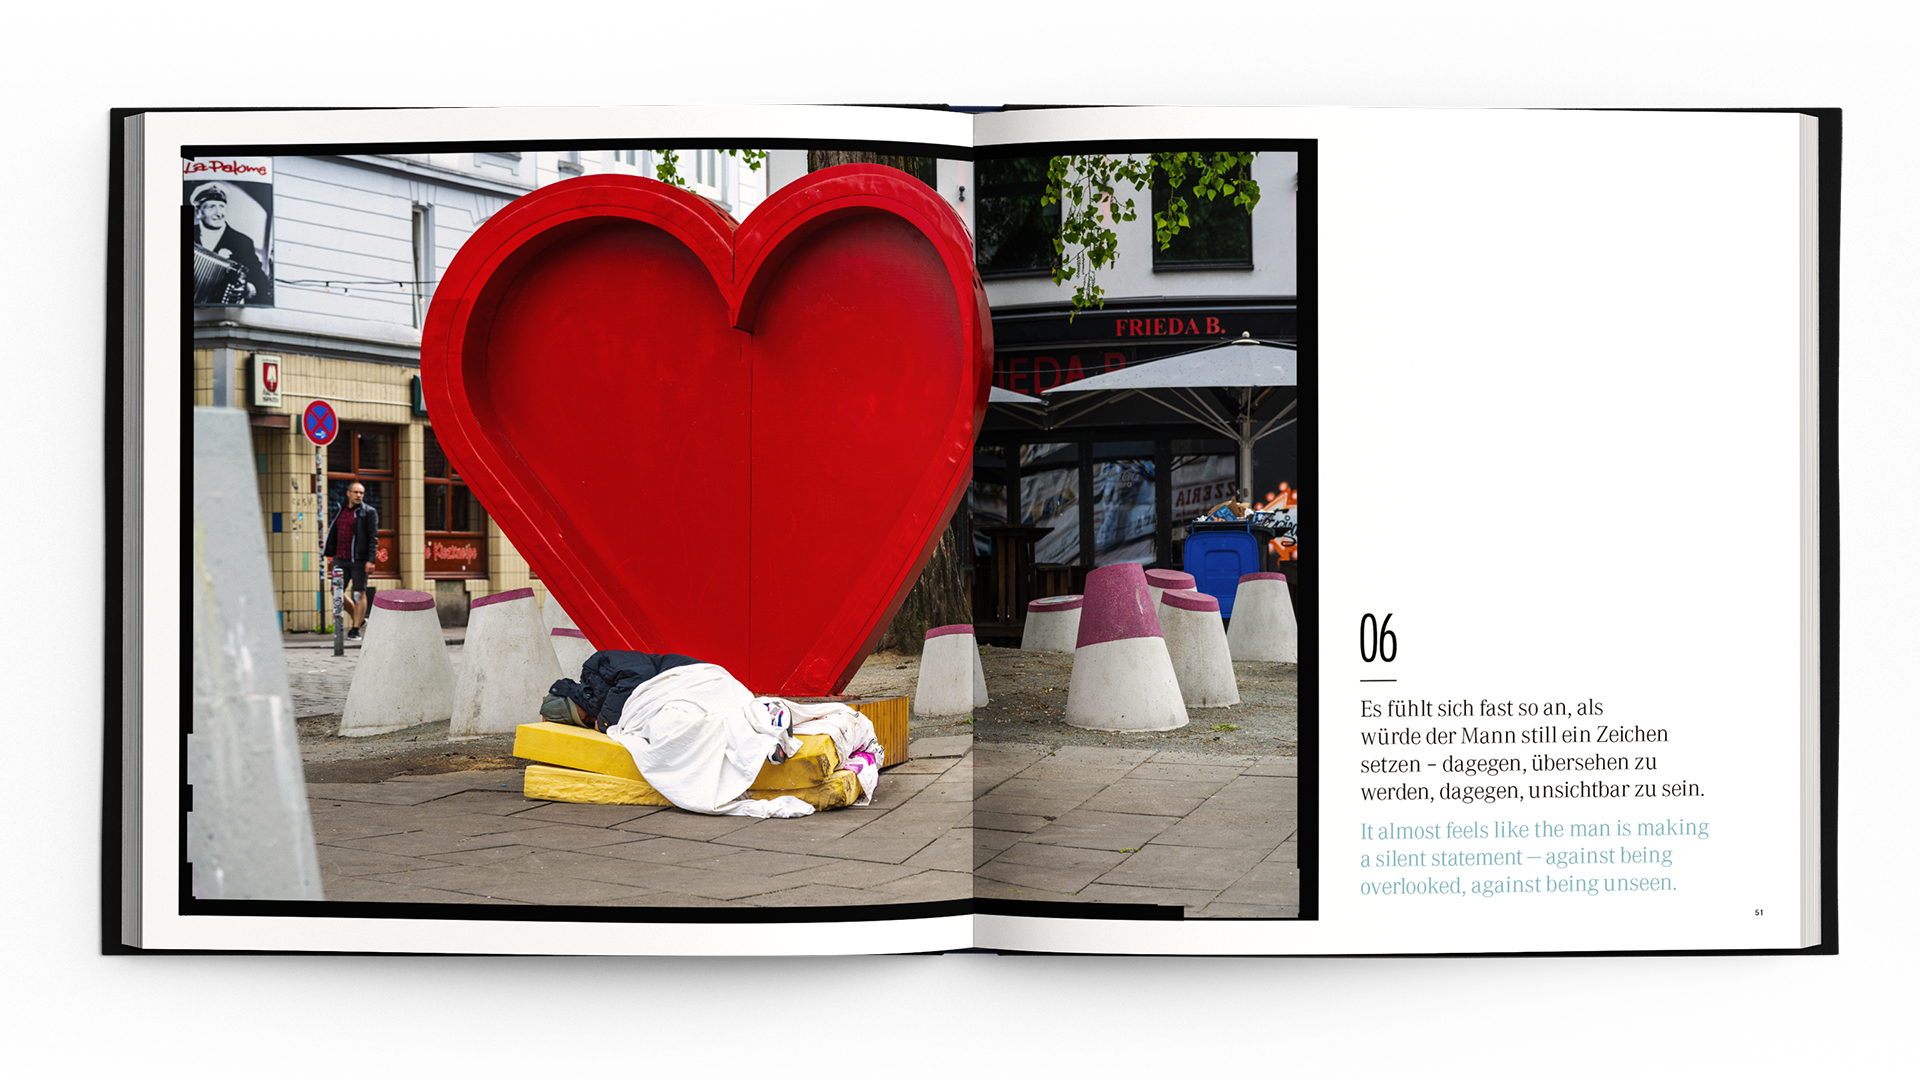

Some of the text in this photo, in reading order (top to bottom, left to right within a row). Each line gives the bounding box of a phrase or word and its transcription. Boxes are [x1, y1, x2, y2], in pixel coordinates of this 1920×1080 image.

[183, 162, 208, 174] La
[1115, 316, 1227, 337] FRIEDA B.
[998, 354, 1086, 395] IEDA
[1359, 612, 1399, 664] 06
[1360, 698, 1604, 720] Es fühlt sich fast so an, als
[1360, 724, 1669, 746] würde der Mann still ein Zeichen
[1360, 756, 1421, 774] setzen
[1442, 754, 1527, 777] dagegen,
[1531, 752, 1629, 772] übersehen
[1634, 756, 1658, 771] zu
[1360, 779, 1705, 805] werden, dagegen, unsichtbar zu sein.
[1361, 818, 1710, 841] It almost feels like the man is making
[1360, 854, 1371, 868] a
[1375, 849, 1427, 868] silent
[1431, 849, 1523, 867] statement
[1545, 847, 1616, 869] against
[1620, 846, 1673, 868] being
[1360, 875, 1677, 898] overlooked, against being unseen.
[1754, 908, 1764, 917] 51
